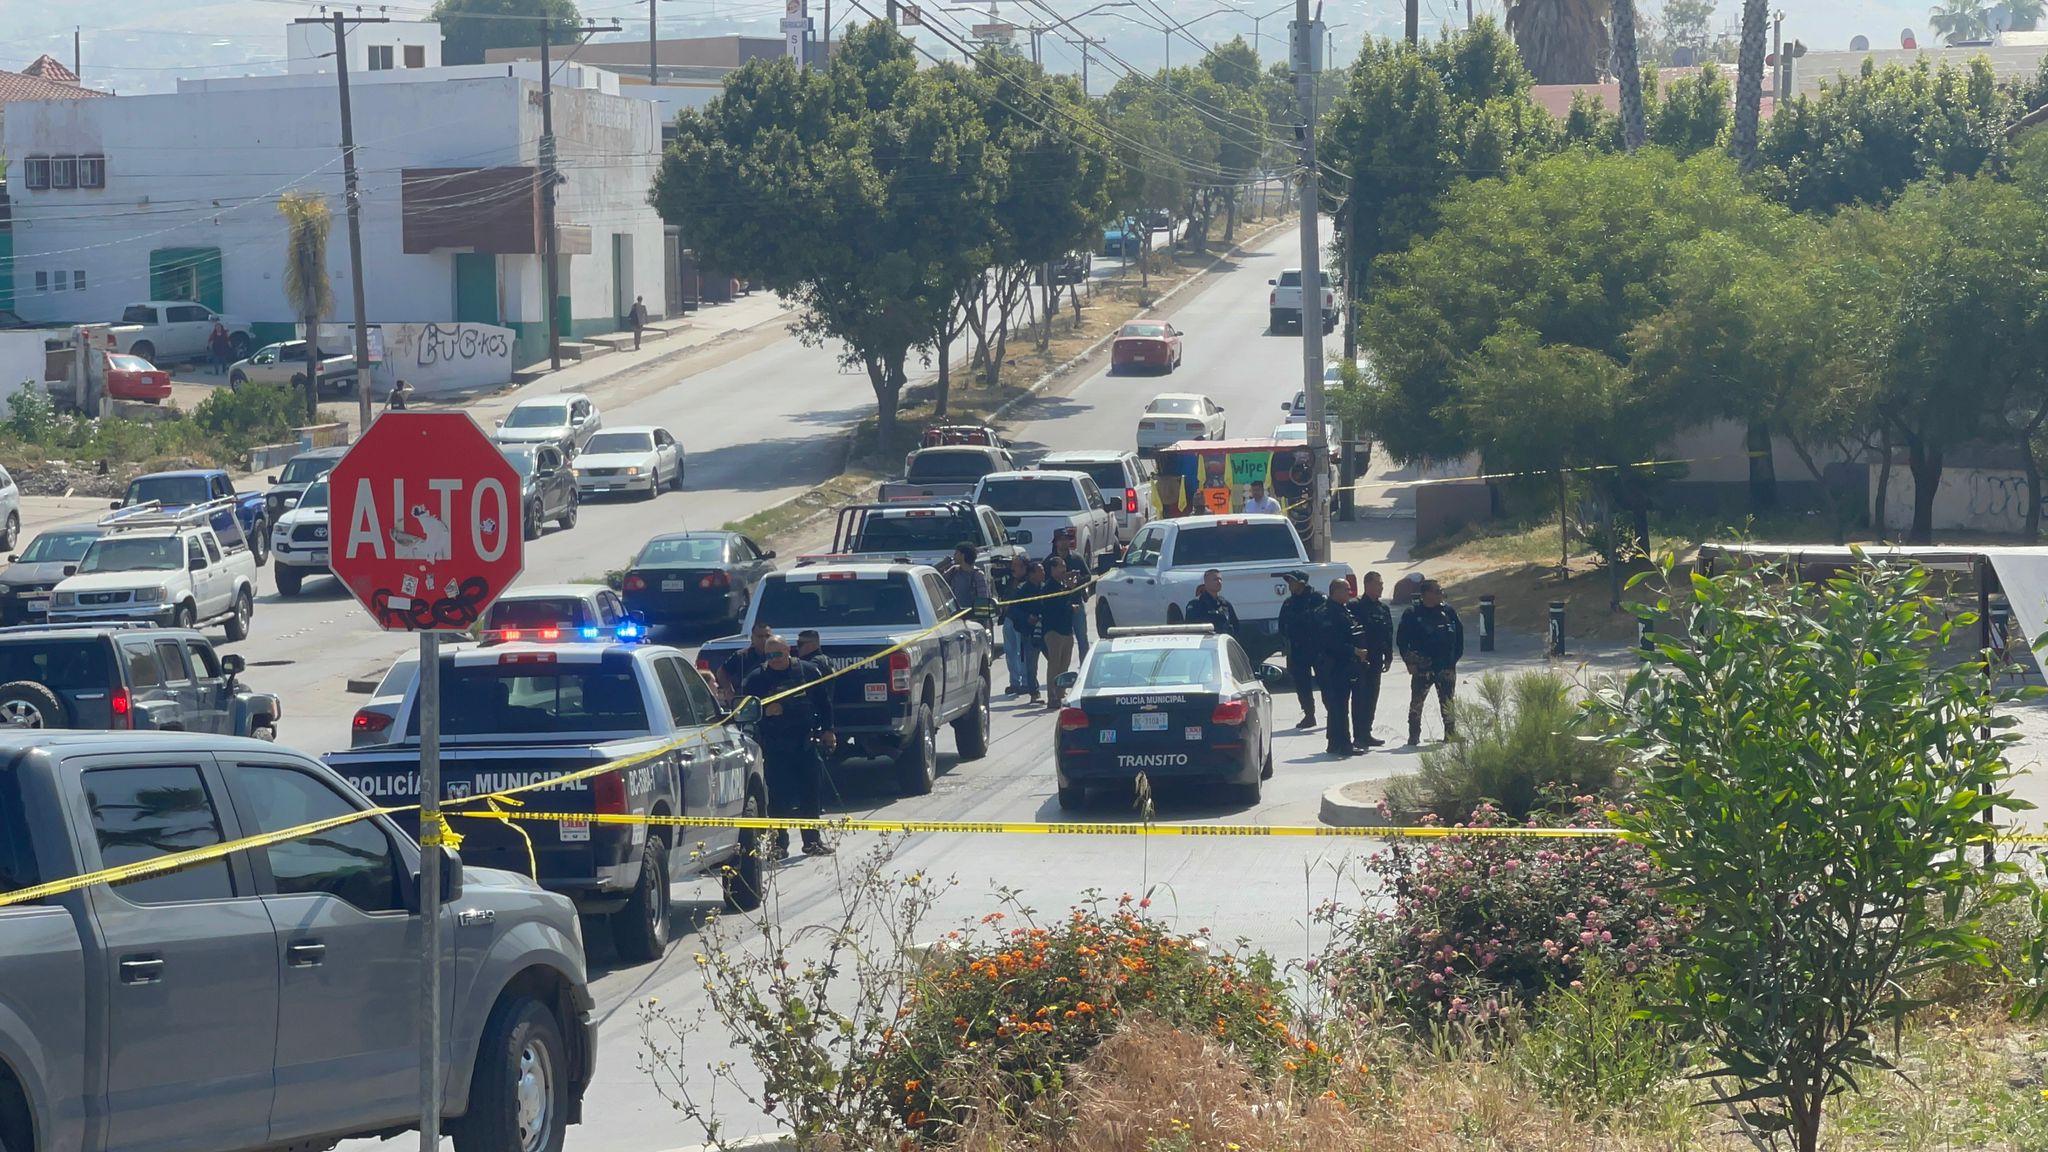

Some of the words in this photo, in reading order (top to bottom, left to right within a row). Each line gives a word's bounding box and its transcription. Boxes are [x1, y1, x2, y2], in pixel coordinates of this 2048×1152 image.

[345, 477, 509, 562] ALTO
[832, 656, 879, 670] NICIPAL
[1146, 694, 1187, 704] MUNICIPAL
[1117, 753, 1188, 767] TRANSITO
[475, 771, 588, 794] MUNICIPAL
